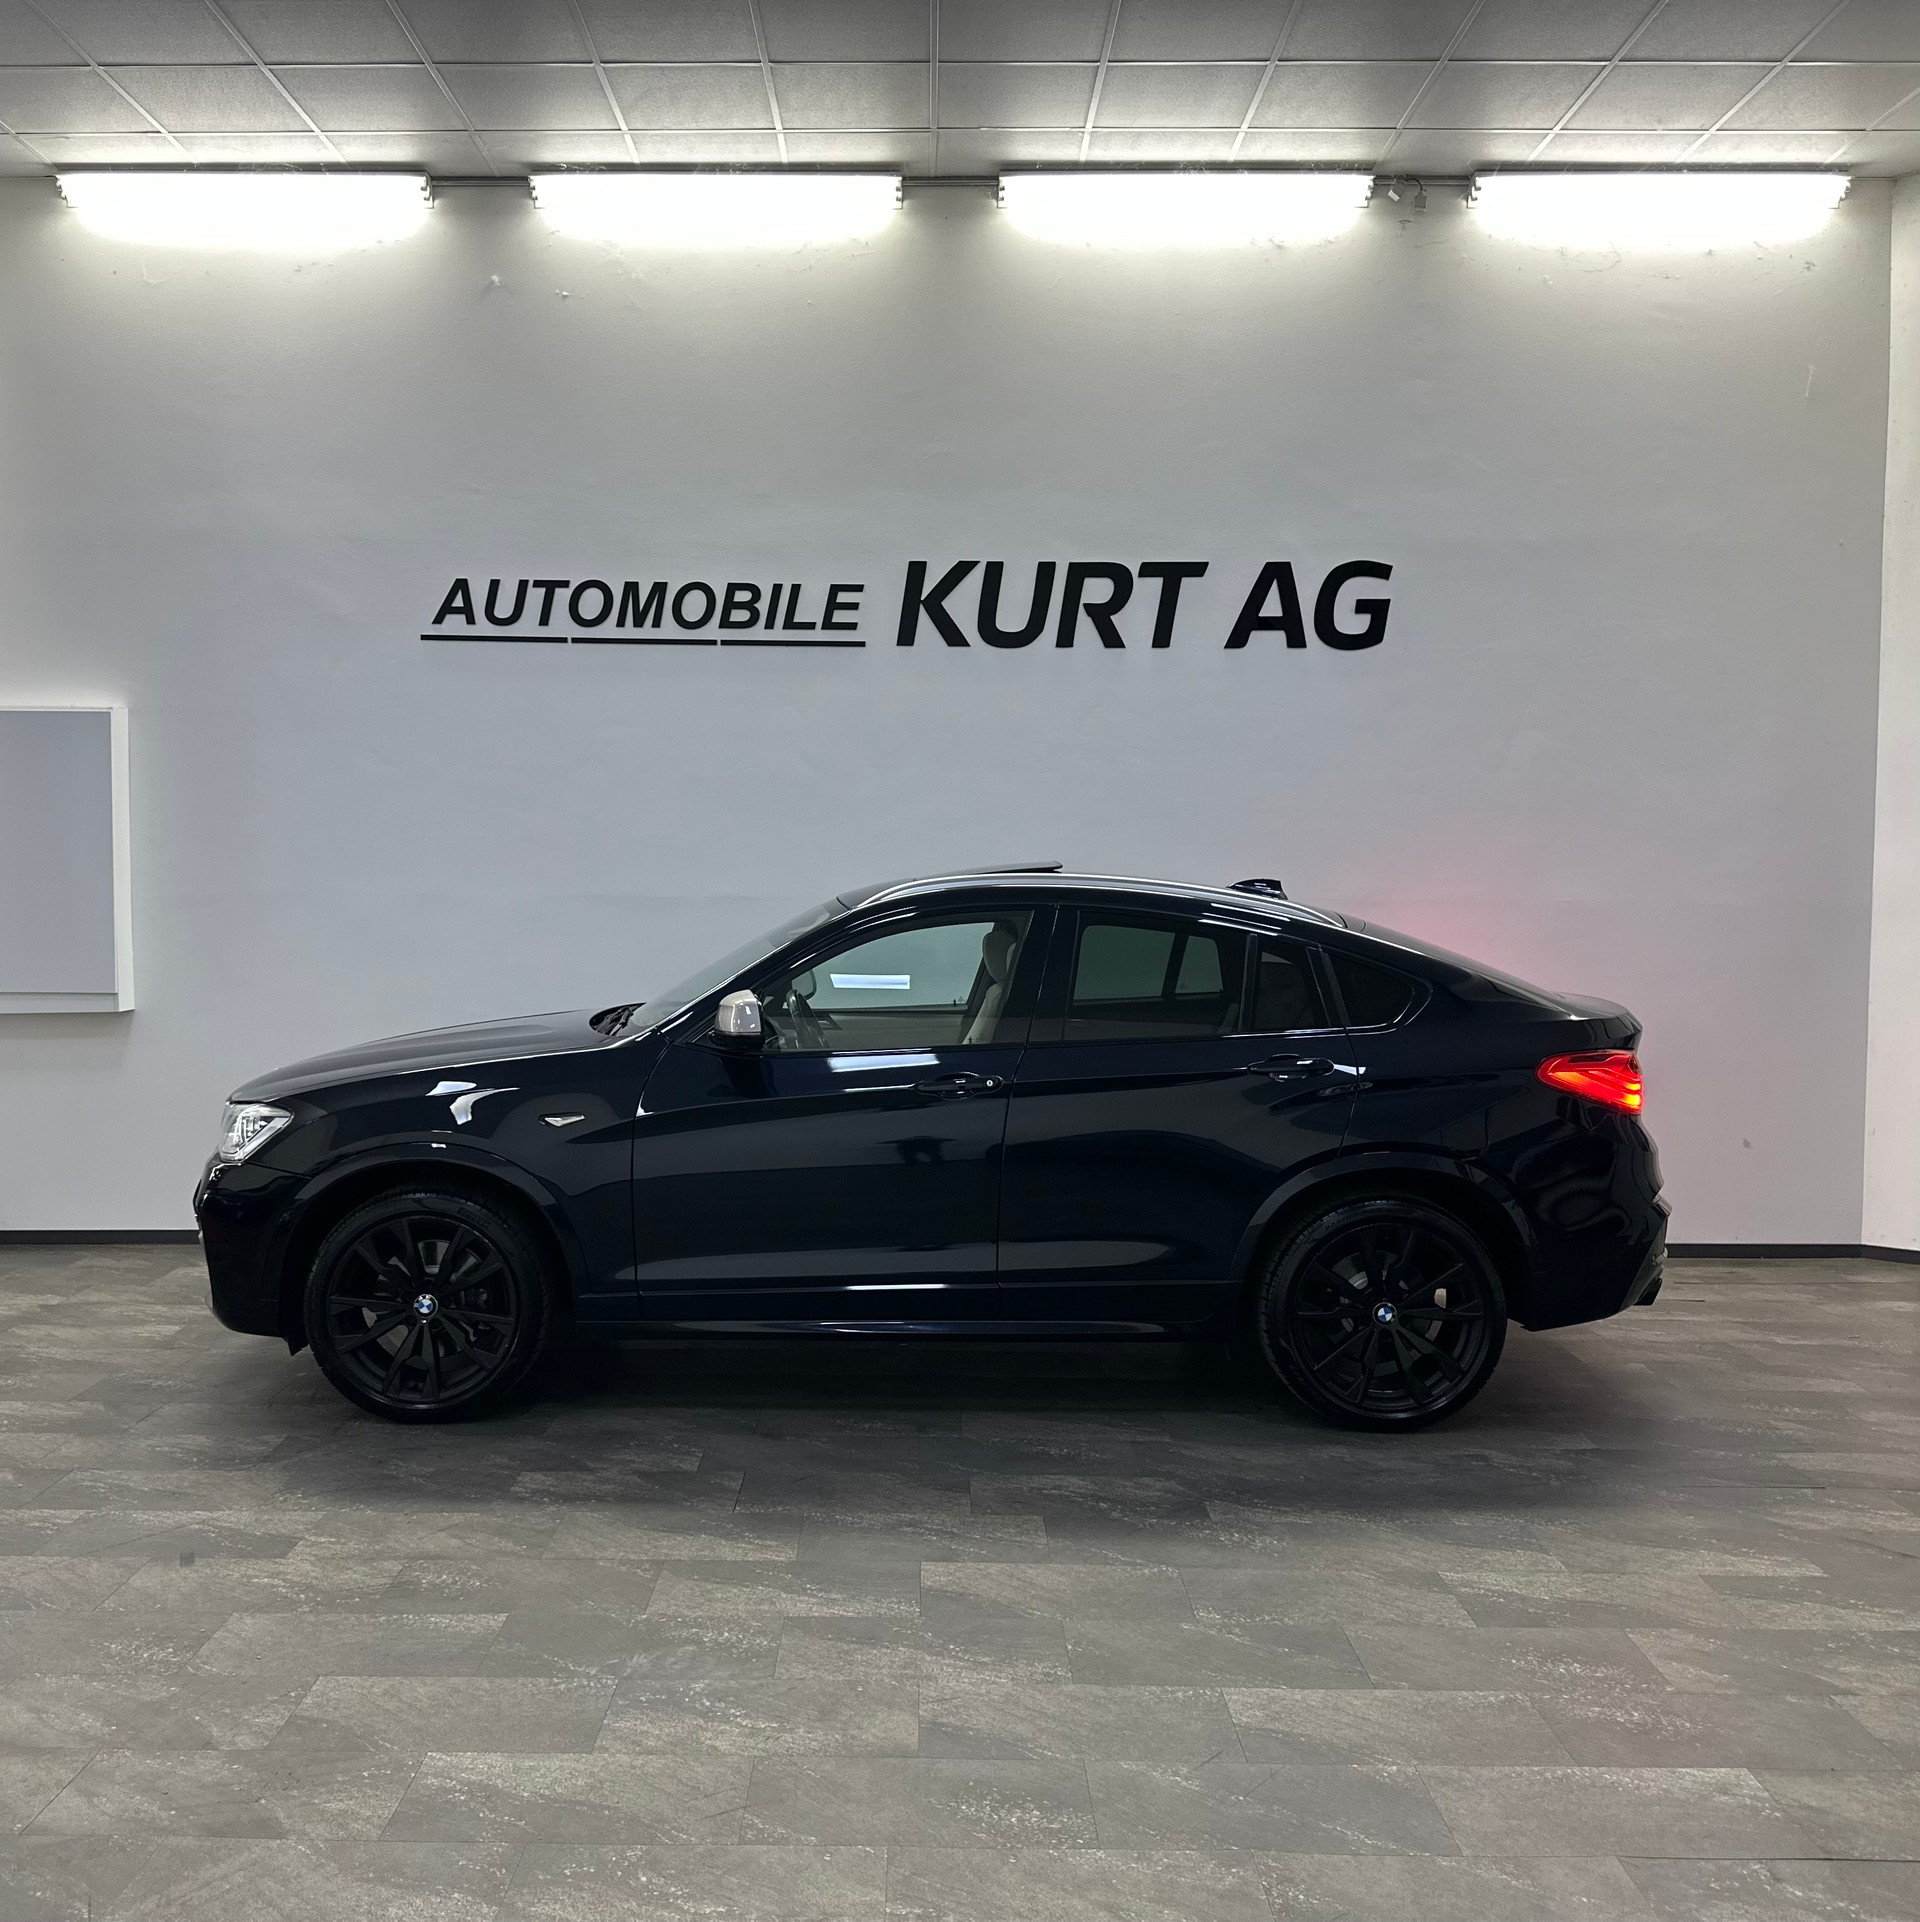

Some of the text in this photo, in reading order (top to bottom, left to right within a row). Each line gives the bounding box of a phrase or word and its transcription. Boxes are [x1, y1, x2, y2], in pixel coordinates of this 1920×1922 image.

[431, 559, 1394, 651] AUTOMOBILE KURT AG
